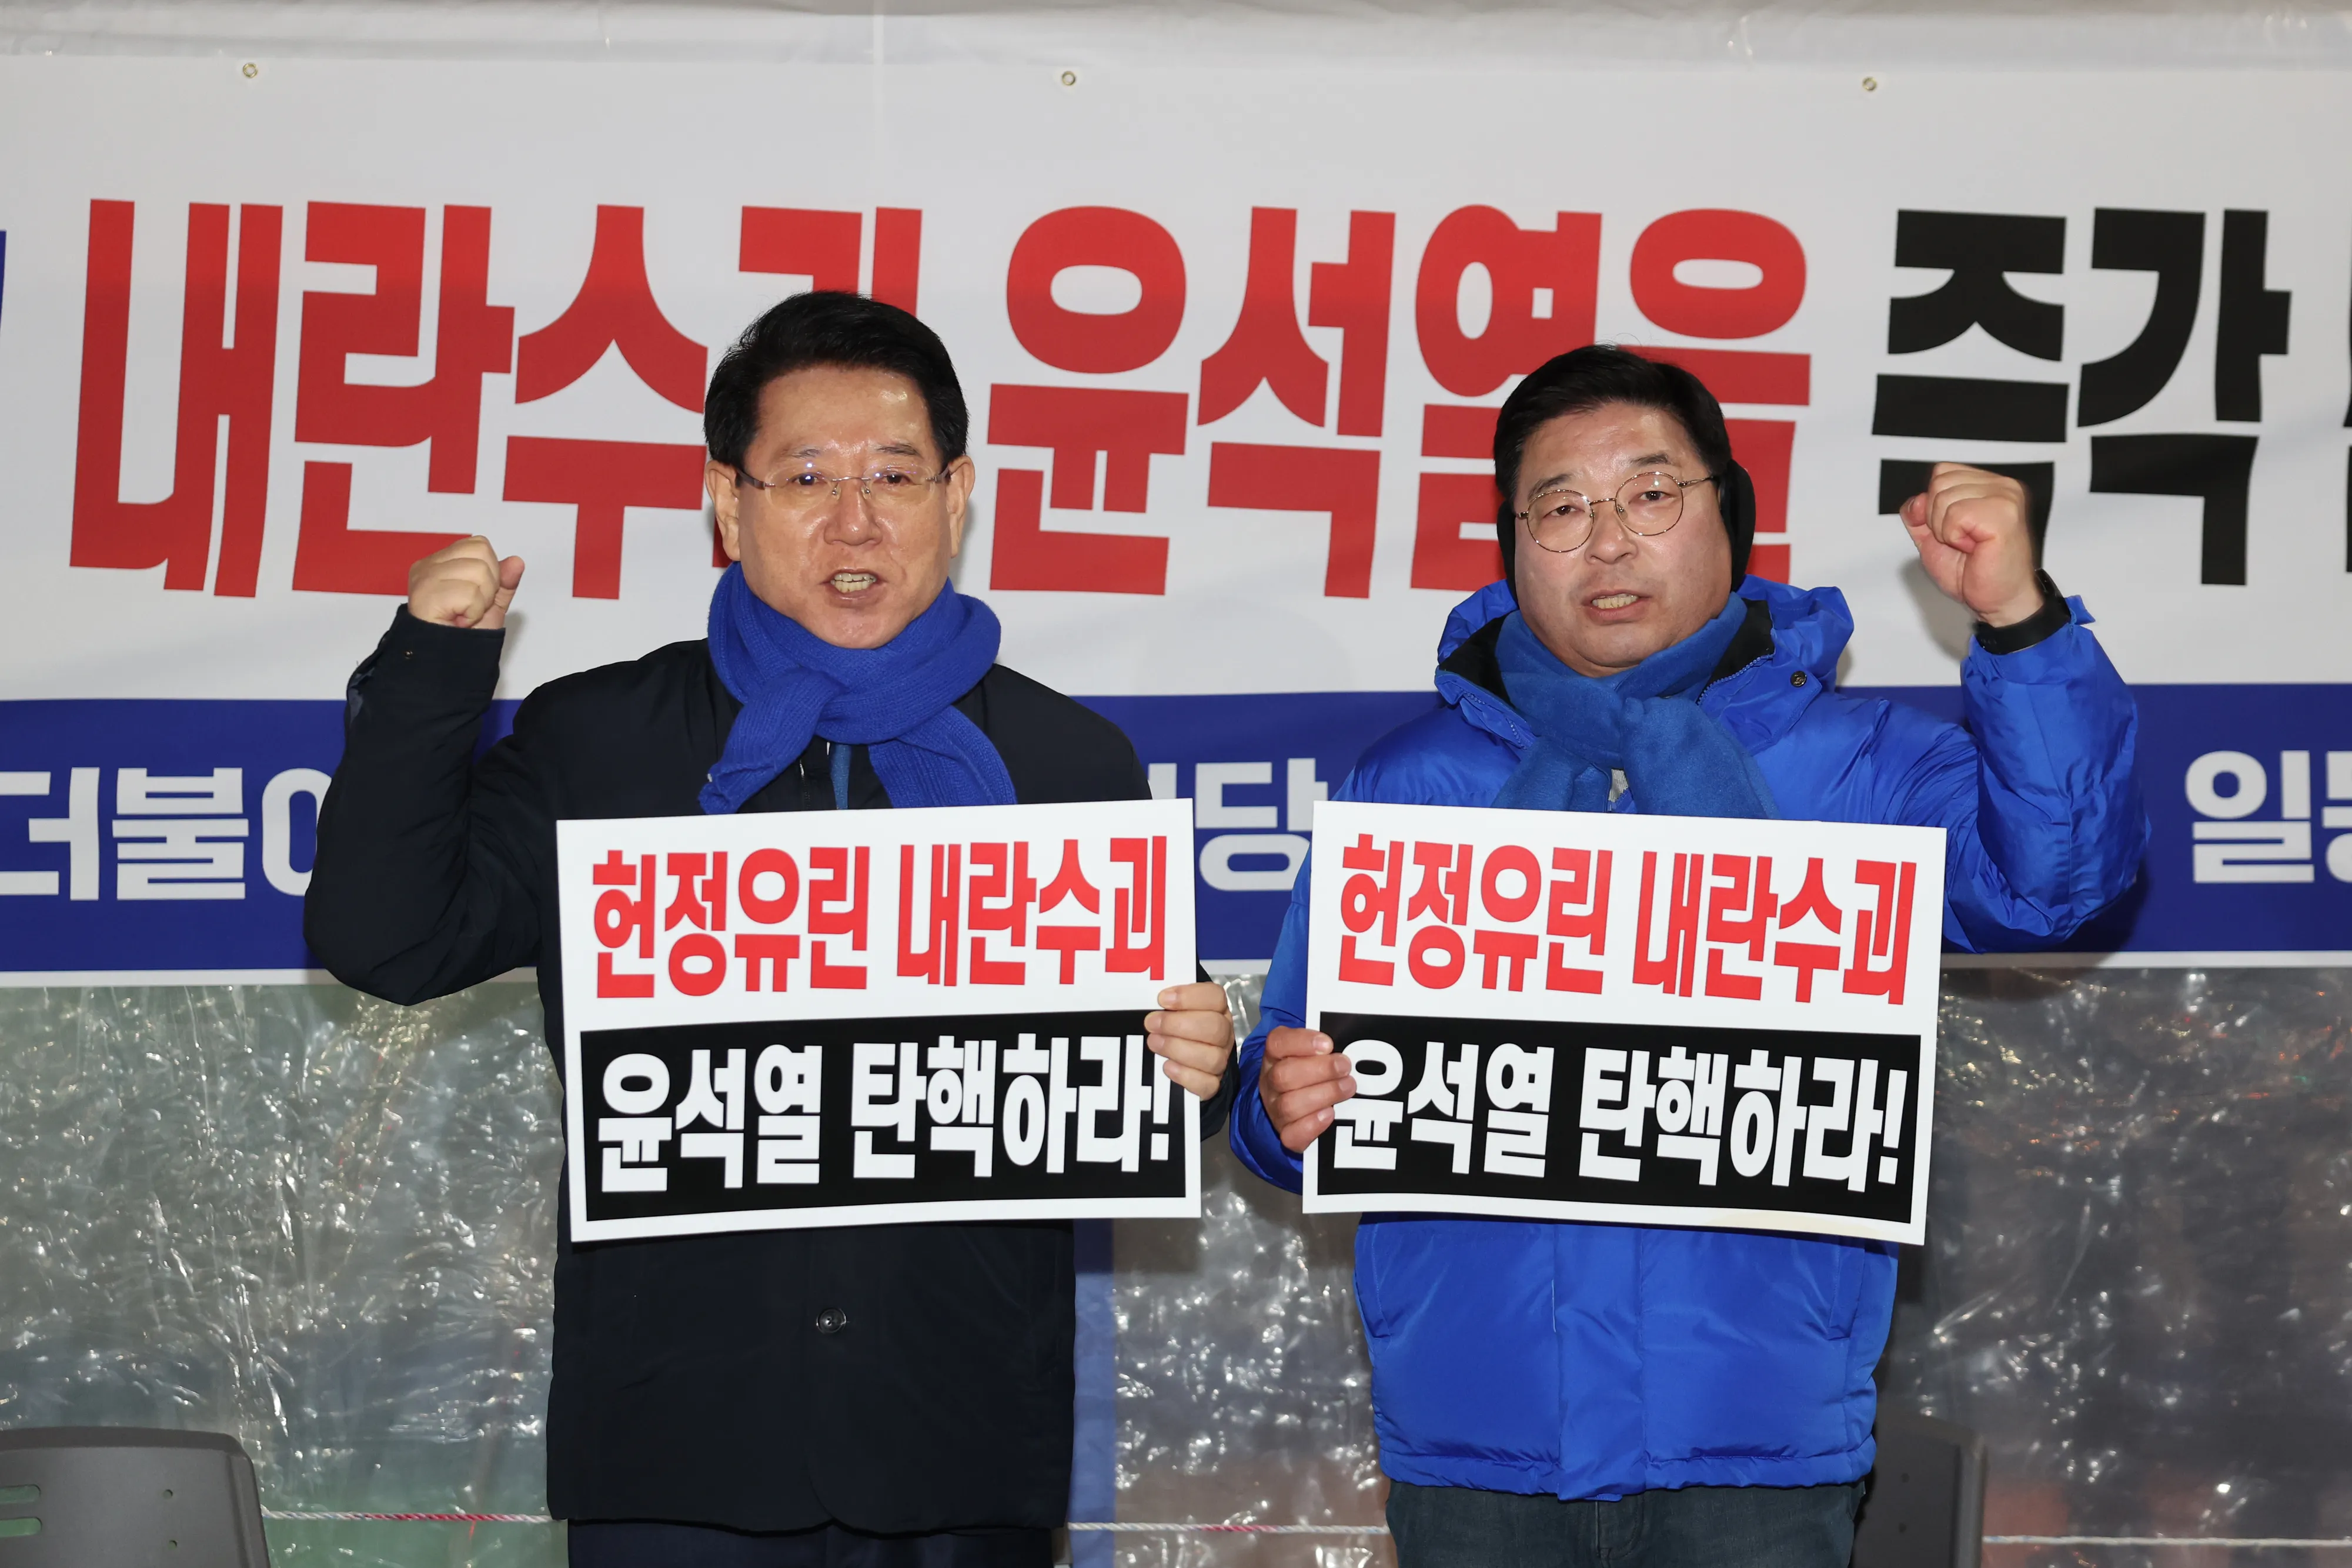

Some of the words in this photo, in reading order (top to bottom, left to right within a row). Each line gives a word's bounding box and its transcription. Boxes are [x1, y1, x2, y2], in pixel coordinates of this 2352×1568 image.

[69, 199, 923, 600] 내란수
[987, 203, 1812, 599] 윤석열을
[1871, 207, 2292, 587] 즉각
[592, 848, 870, 999] 헌정유린
[896, 835, 1167, 987] 내란수괴
[1338, 833, 1613, 995] 헌정유린
[1632, 850, 1917, 1006] 내란수괴
[598, 1044, 821, 1193] 윤석열
[851, 1032, 1170, 1179] 탄핵하라!
[1332, 1039, 1554, 1178] 윤석열
[1578, 1046, 1907, 1193] 탄핵하라!
